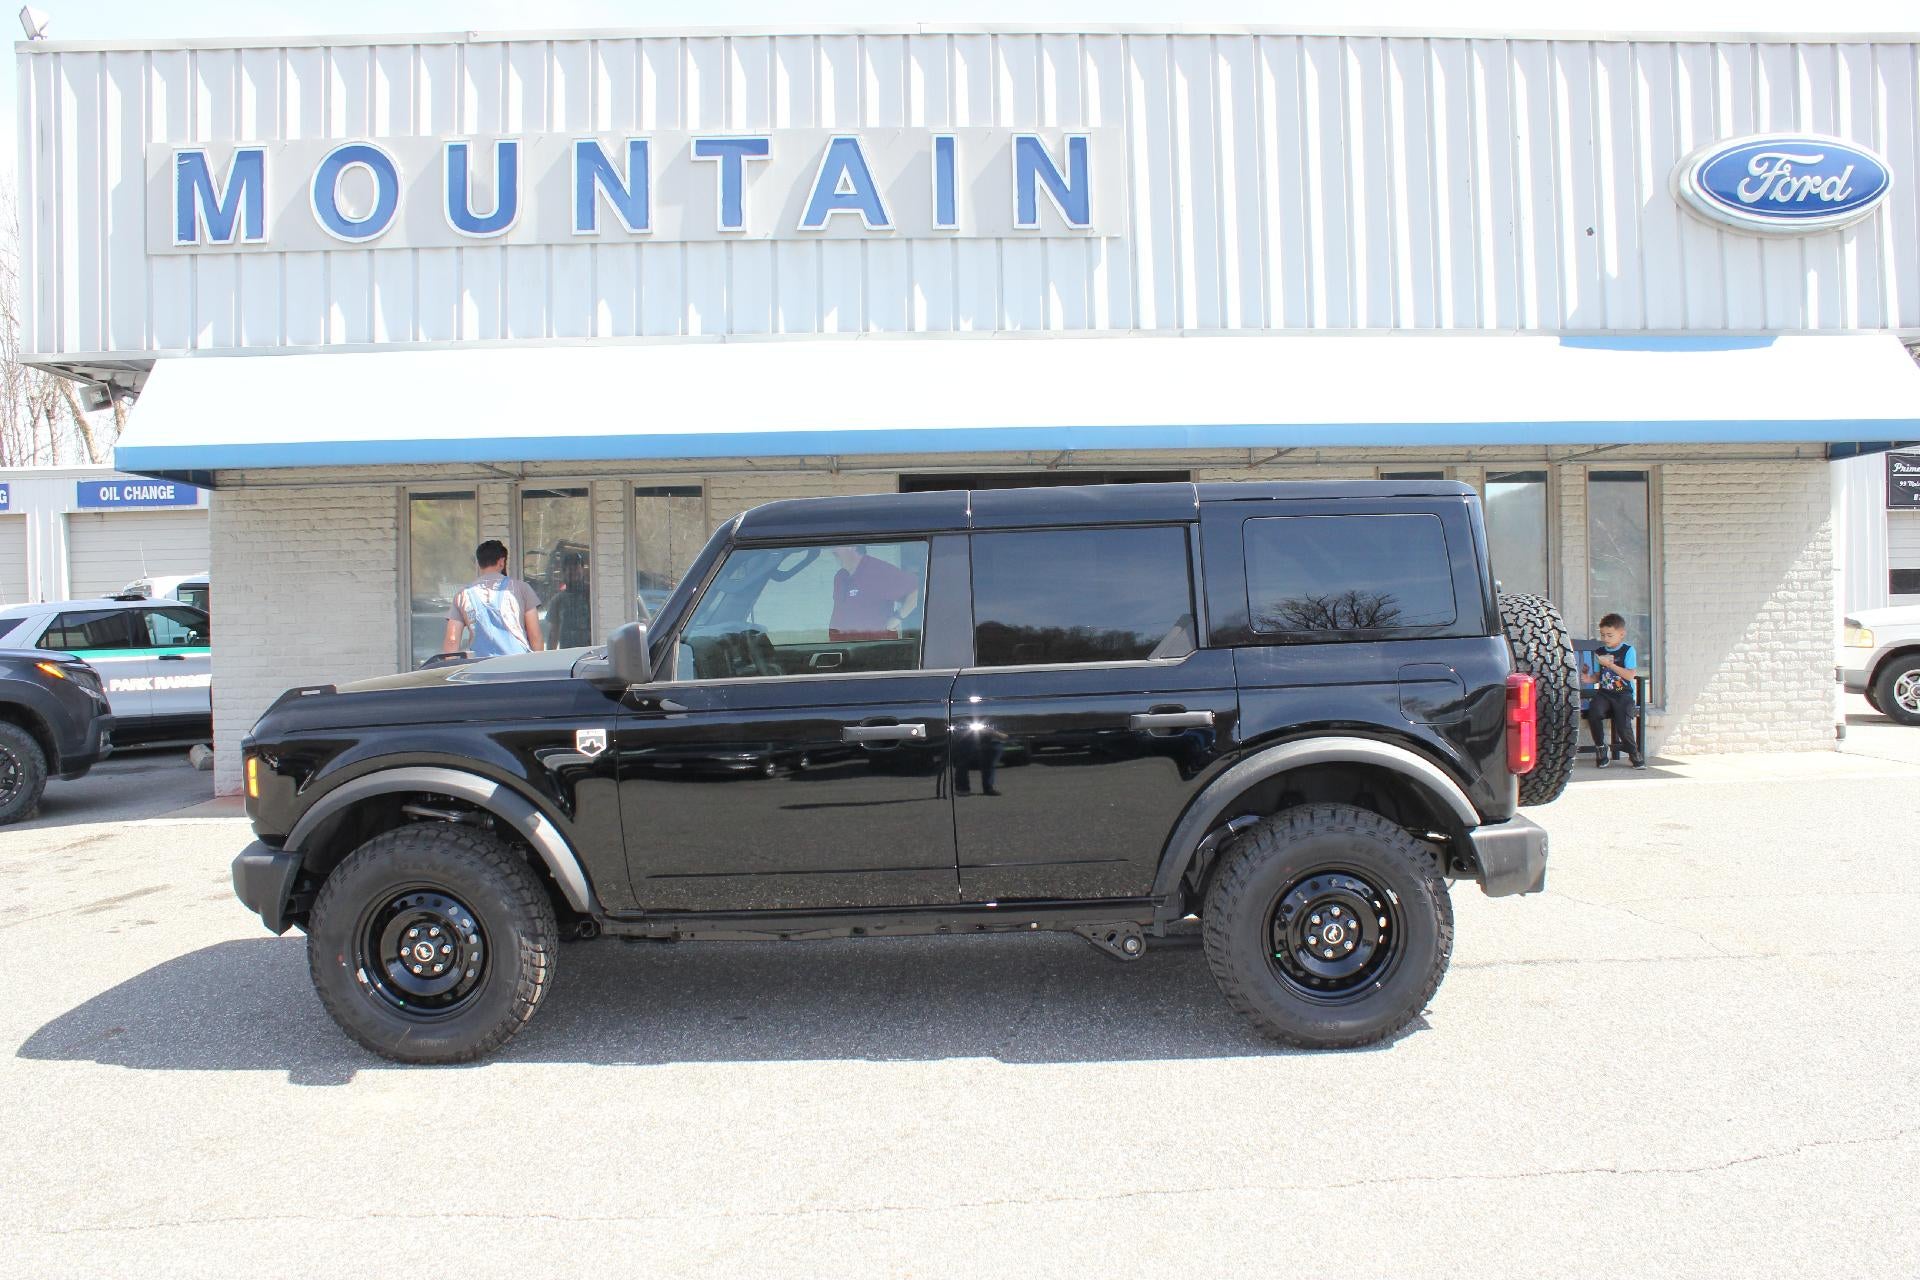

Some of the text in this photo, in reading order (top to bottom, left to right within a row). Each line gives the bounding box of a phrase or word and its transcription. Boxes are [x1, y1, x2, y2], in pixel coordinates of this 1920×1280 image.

[174, 132, 1092, 247] MOUNTAIN
[1737, 152, 1854, 203] Ford
[100, 485, 175, 501] OIL CHANGE
[109, 679, 153, 692] PARK
